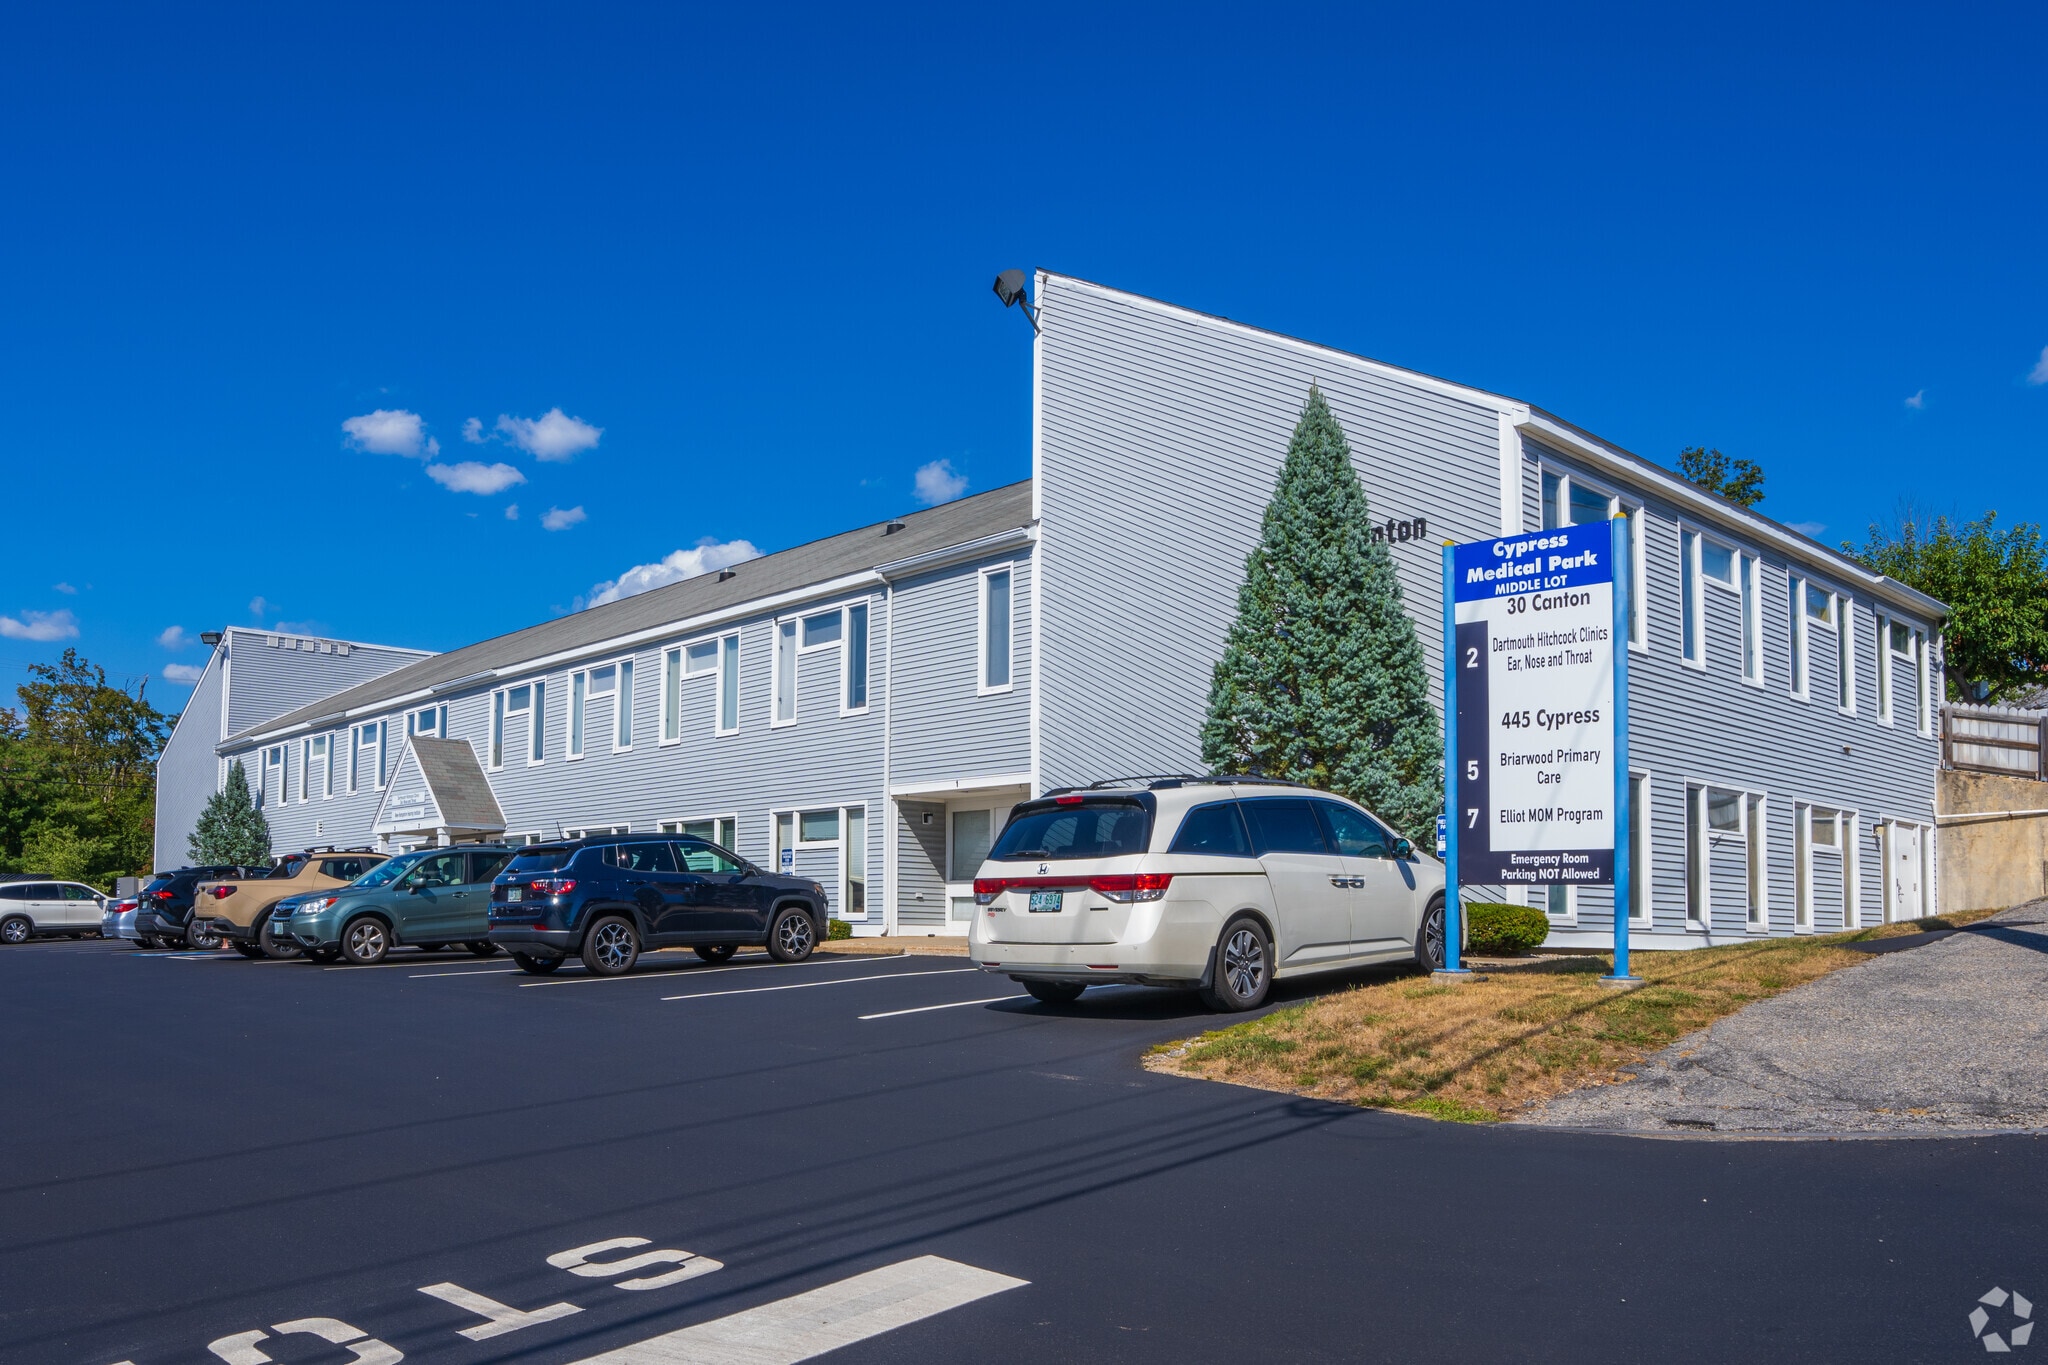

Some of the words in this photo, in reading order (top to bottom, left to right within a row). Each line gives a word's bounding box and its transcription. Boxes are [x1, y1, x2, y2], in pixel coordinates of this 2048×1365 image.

[1370, 517, 1427, 546] nton
[1492, 534, 1569, 560] Cypress
[1466, 557, 1542, 584] Medical
[1548, 550, 1598, 571] Park
[1495, 578, 1541, 595] MIDDLE
[1544, 574, 1568, 589] LOT
[1507, 596, 1526, 615] 30
[1532, 591, 1591, 612] Canton
[1492, 632, 1535, 653] Dartmouth
[1537, 628, 1578, 648] Hitchcock
[1579, 625, 1608, 642] Clinics
[1466, 647, 1479, 669] 2
[1507, 656, 1523, 672] Ear,
[1525, 654, 1546, 670] Nose
[1547, 651, 1563, 667] and
[1565, 649, 1593, 665] Throat
[1501, 710, 1531, 729] 445
[1536, 708, 1600, 731] Cypress
[1500, 750, 1553, 767] Briarwood
[1557, 748, 1601, 764] Primary
[1467, 759, 1479, 781] 5
[1537, 771, 1561, 785] Care
[1467, 808, 1480, 829] 7
[1500, 809, 1525, 824] Elliot
[1528, 808, 1553, 822] MOM
[1557, 807, 1603, 825] Program
[1511, 853, 1561, 867] Emergency
[1562, 852, 1589, 864] Room
[1501, 868, 1537, 882] Parking
[1539, 868, 1560, 880] NOT
[1561, 867, 1600, 880] Allowed
[112, 1236, 725, 1365] STO
